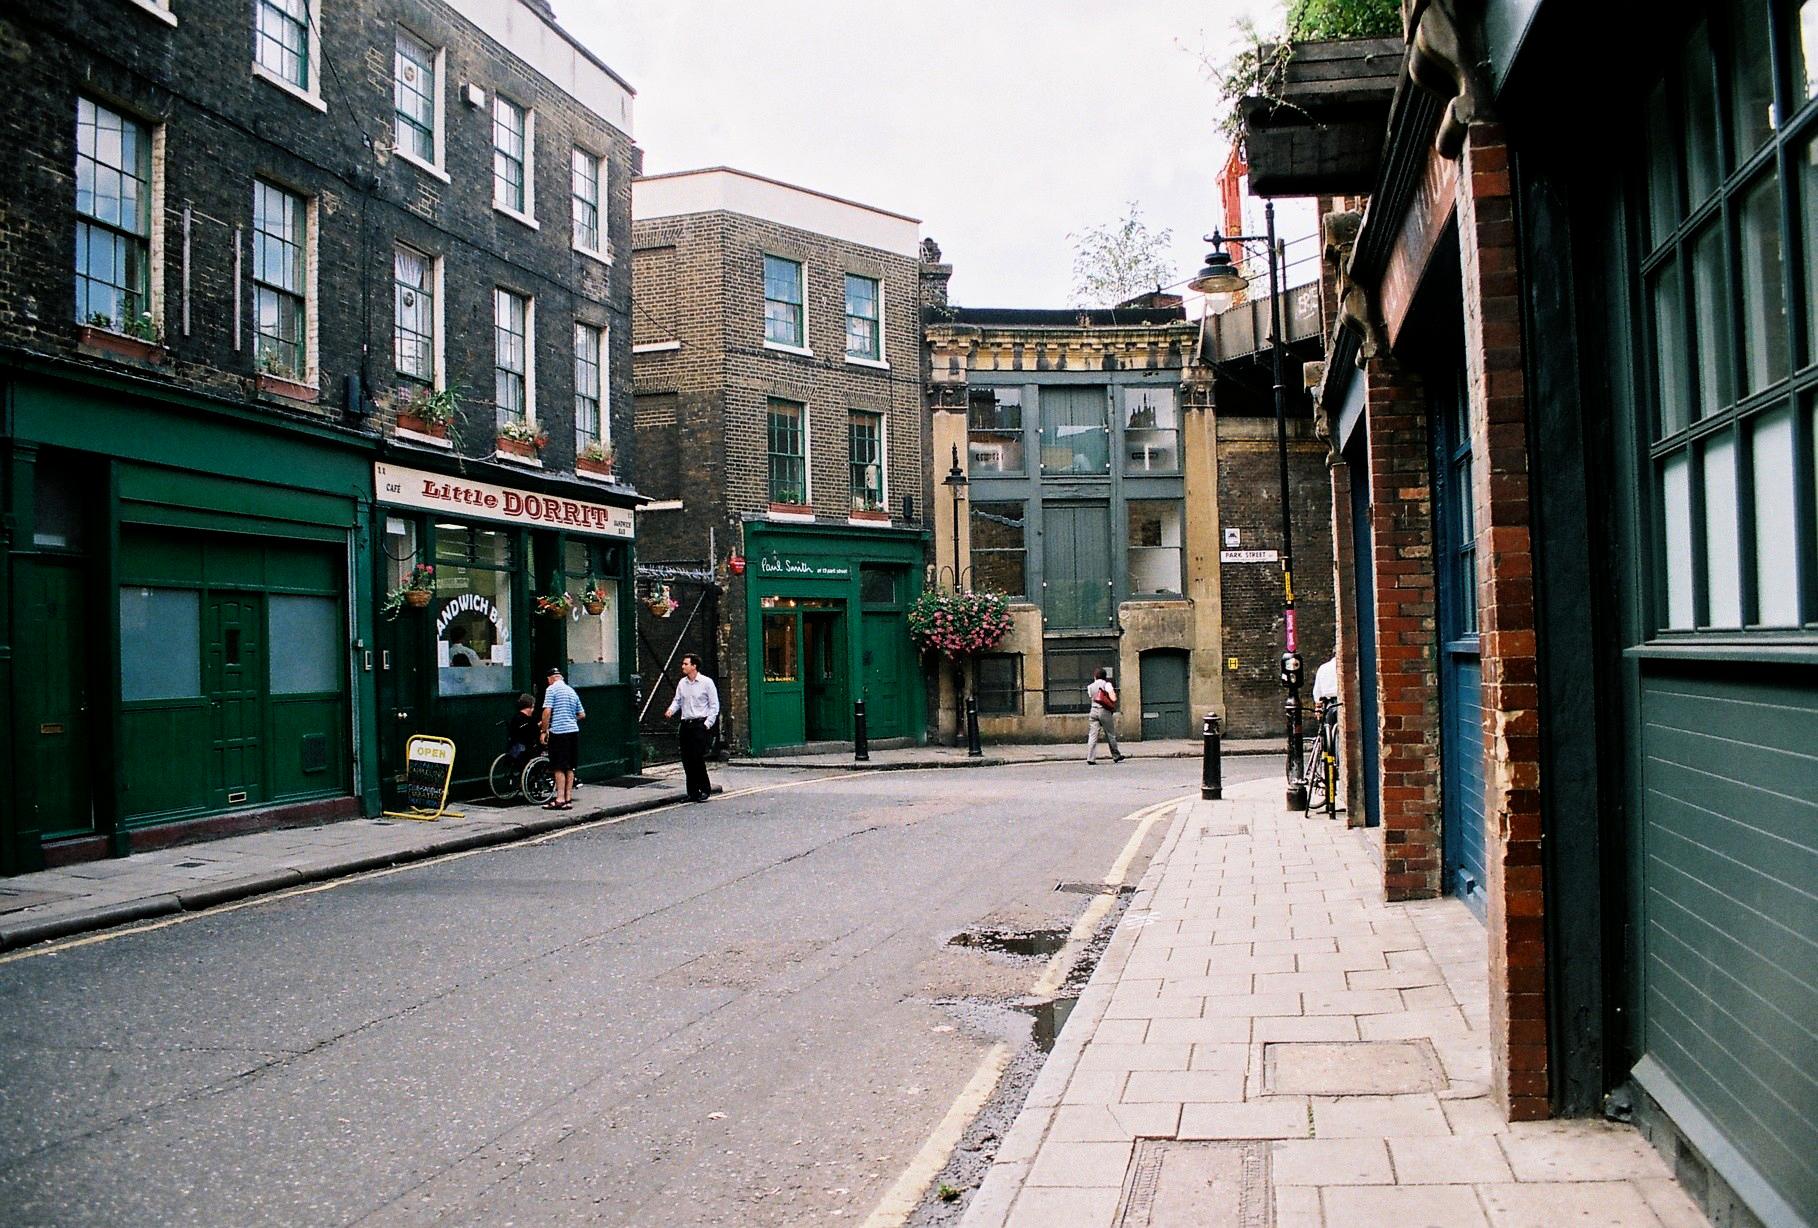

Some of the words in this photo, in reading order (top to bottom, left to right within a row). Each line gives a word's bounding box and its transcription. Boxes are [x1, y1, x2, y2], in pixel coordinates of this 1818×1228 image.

[421, 480, 498, 508] Little
[502, 490, 608, 529] DORRIT
[761, 557, 783, 572] Paul
[785, 560, 814, 573] Smith
[417, 747, 446, 758] OPEN
